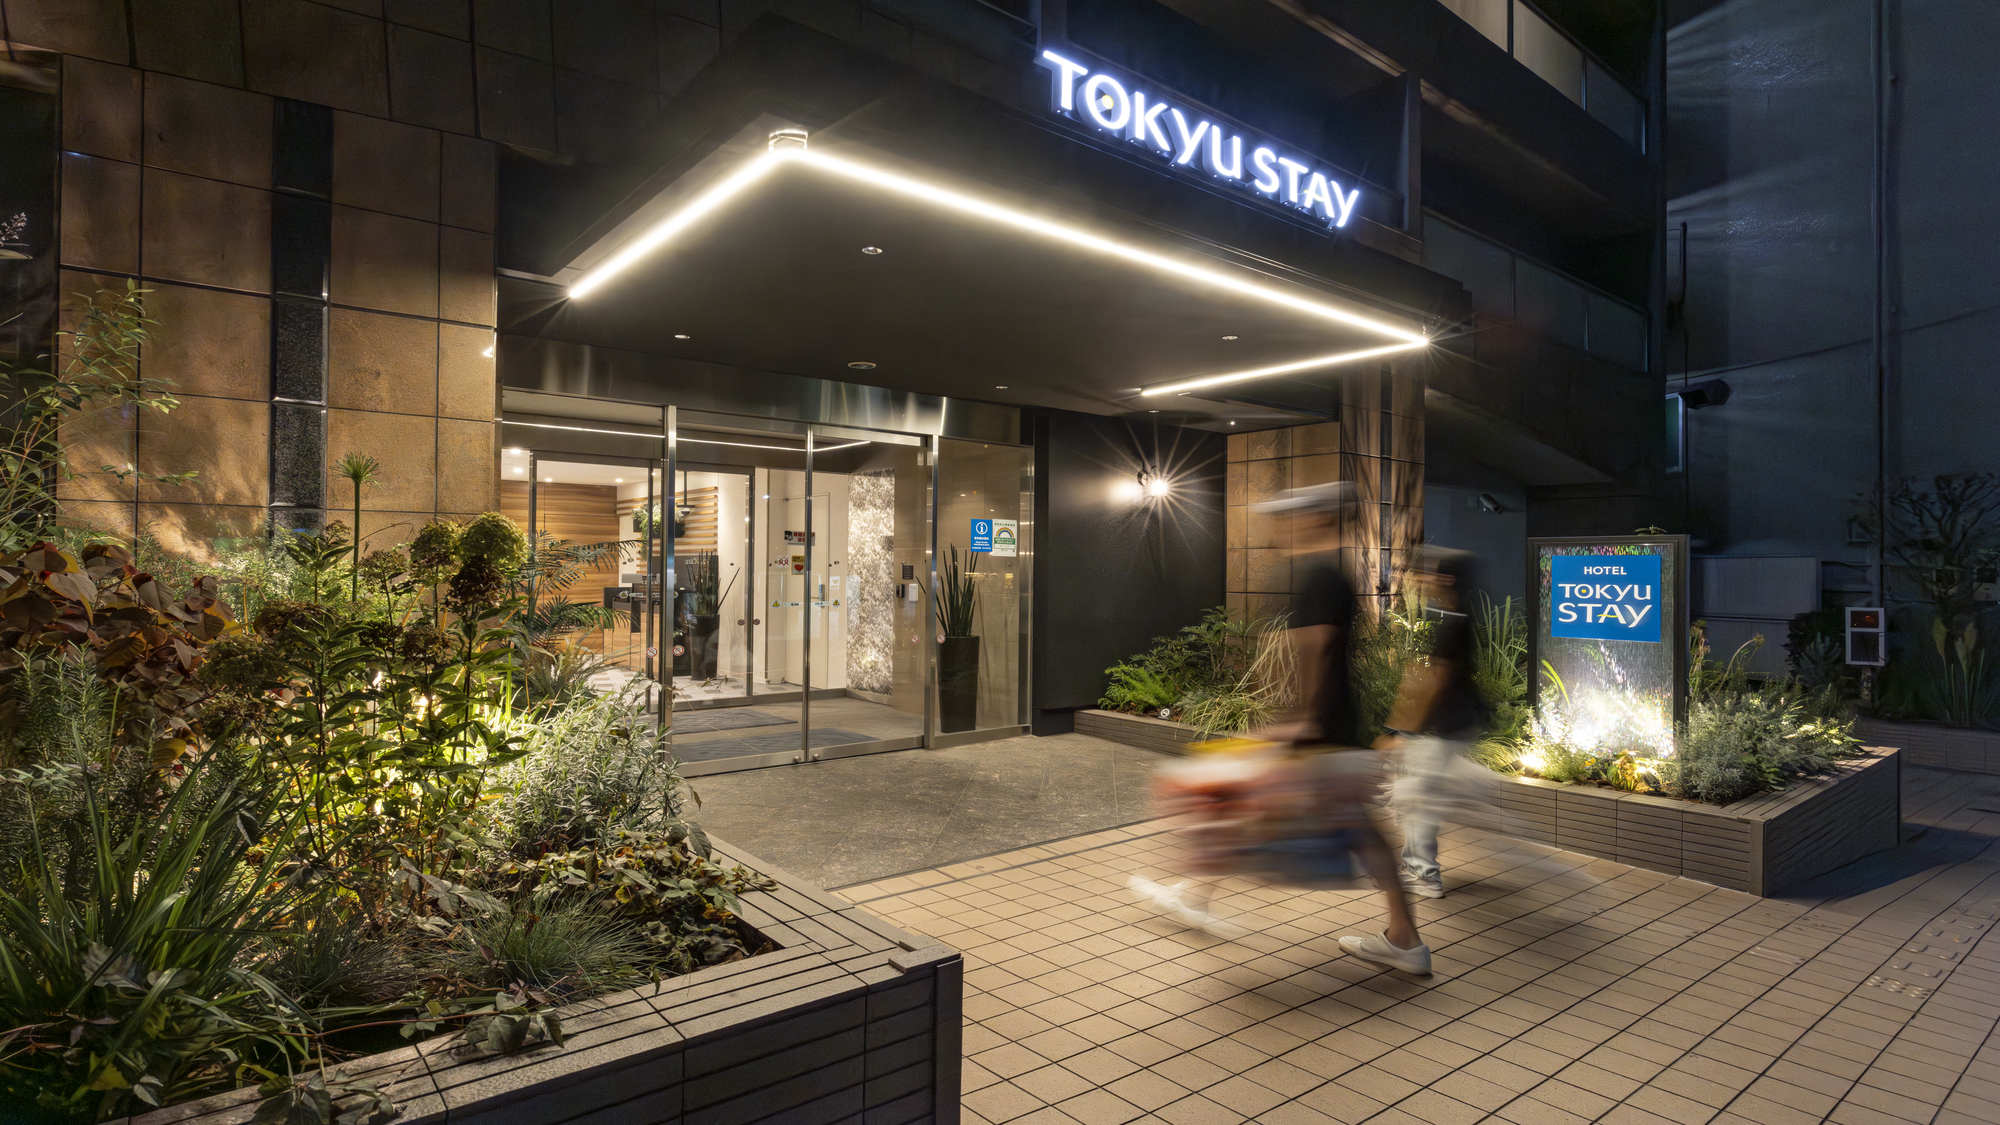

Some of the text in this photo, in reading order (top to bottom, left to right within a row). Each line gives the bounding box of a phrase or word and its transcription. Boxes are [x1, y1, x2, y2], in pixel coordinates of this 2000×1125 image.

[1042, 50, 1359, 228] TOKYU STAY
[1583, 566, 1627, 575] HOTEL
[1558, 583, 1651, 601] TOKYU
[1558, 602, 1652, 628] STAY
